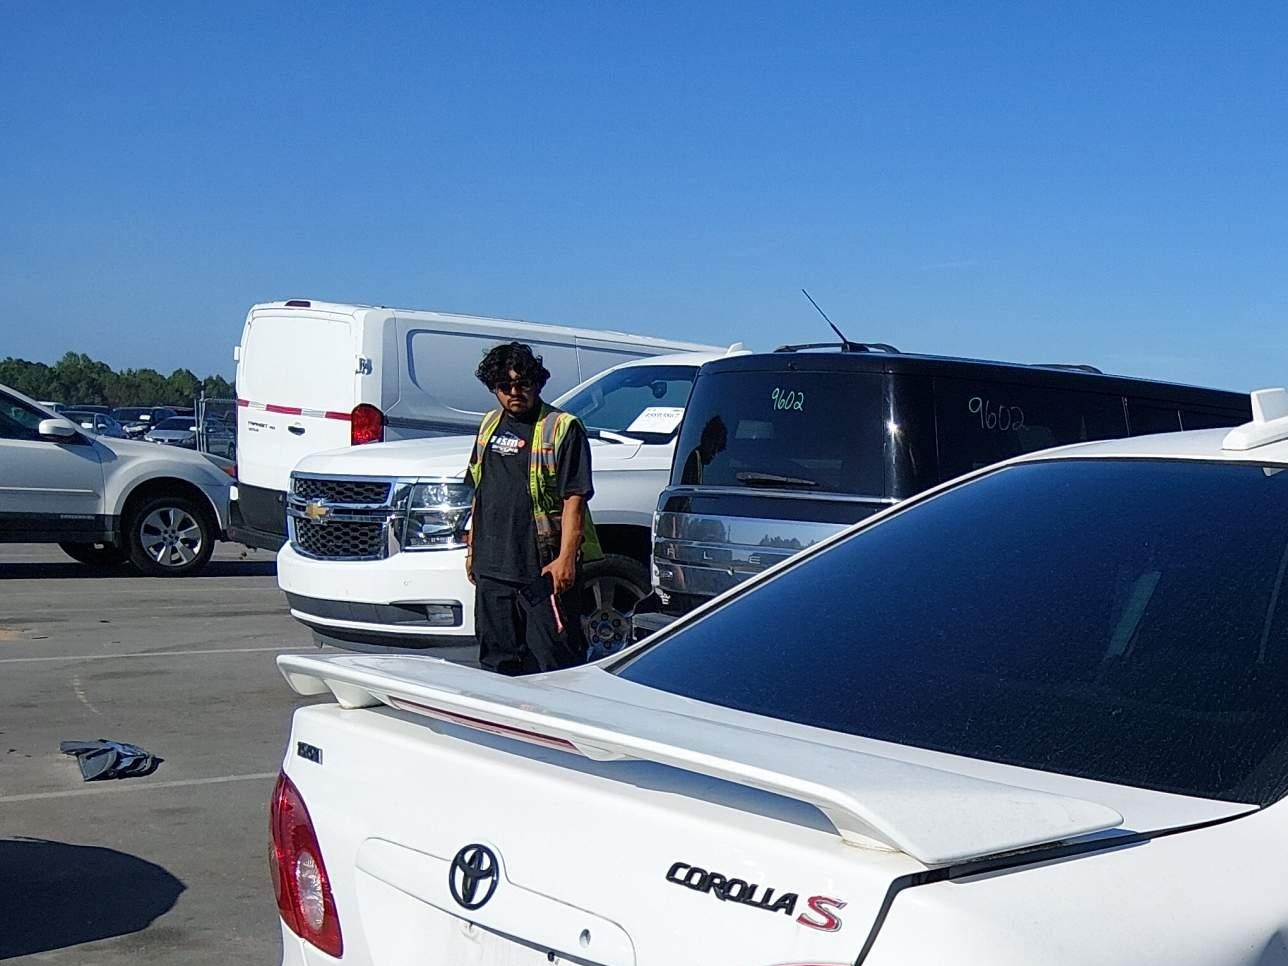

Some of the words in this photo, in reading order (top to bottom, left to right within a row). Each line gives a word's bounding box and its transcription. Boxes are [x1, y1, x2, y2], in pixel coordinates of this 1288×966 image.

[771, 387, 804, 412] 9602
[968, 396, 1030, 431] 9602
[665, 861, 799, 917] COROLLA
[795, 894, 848, 933] S
